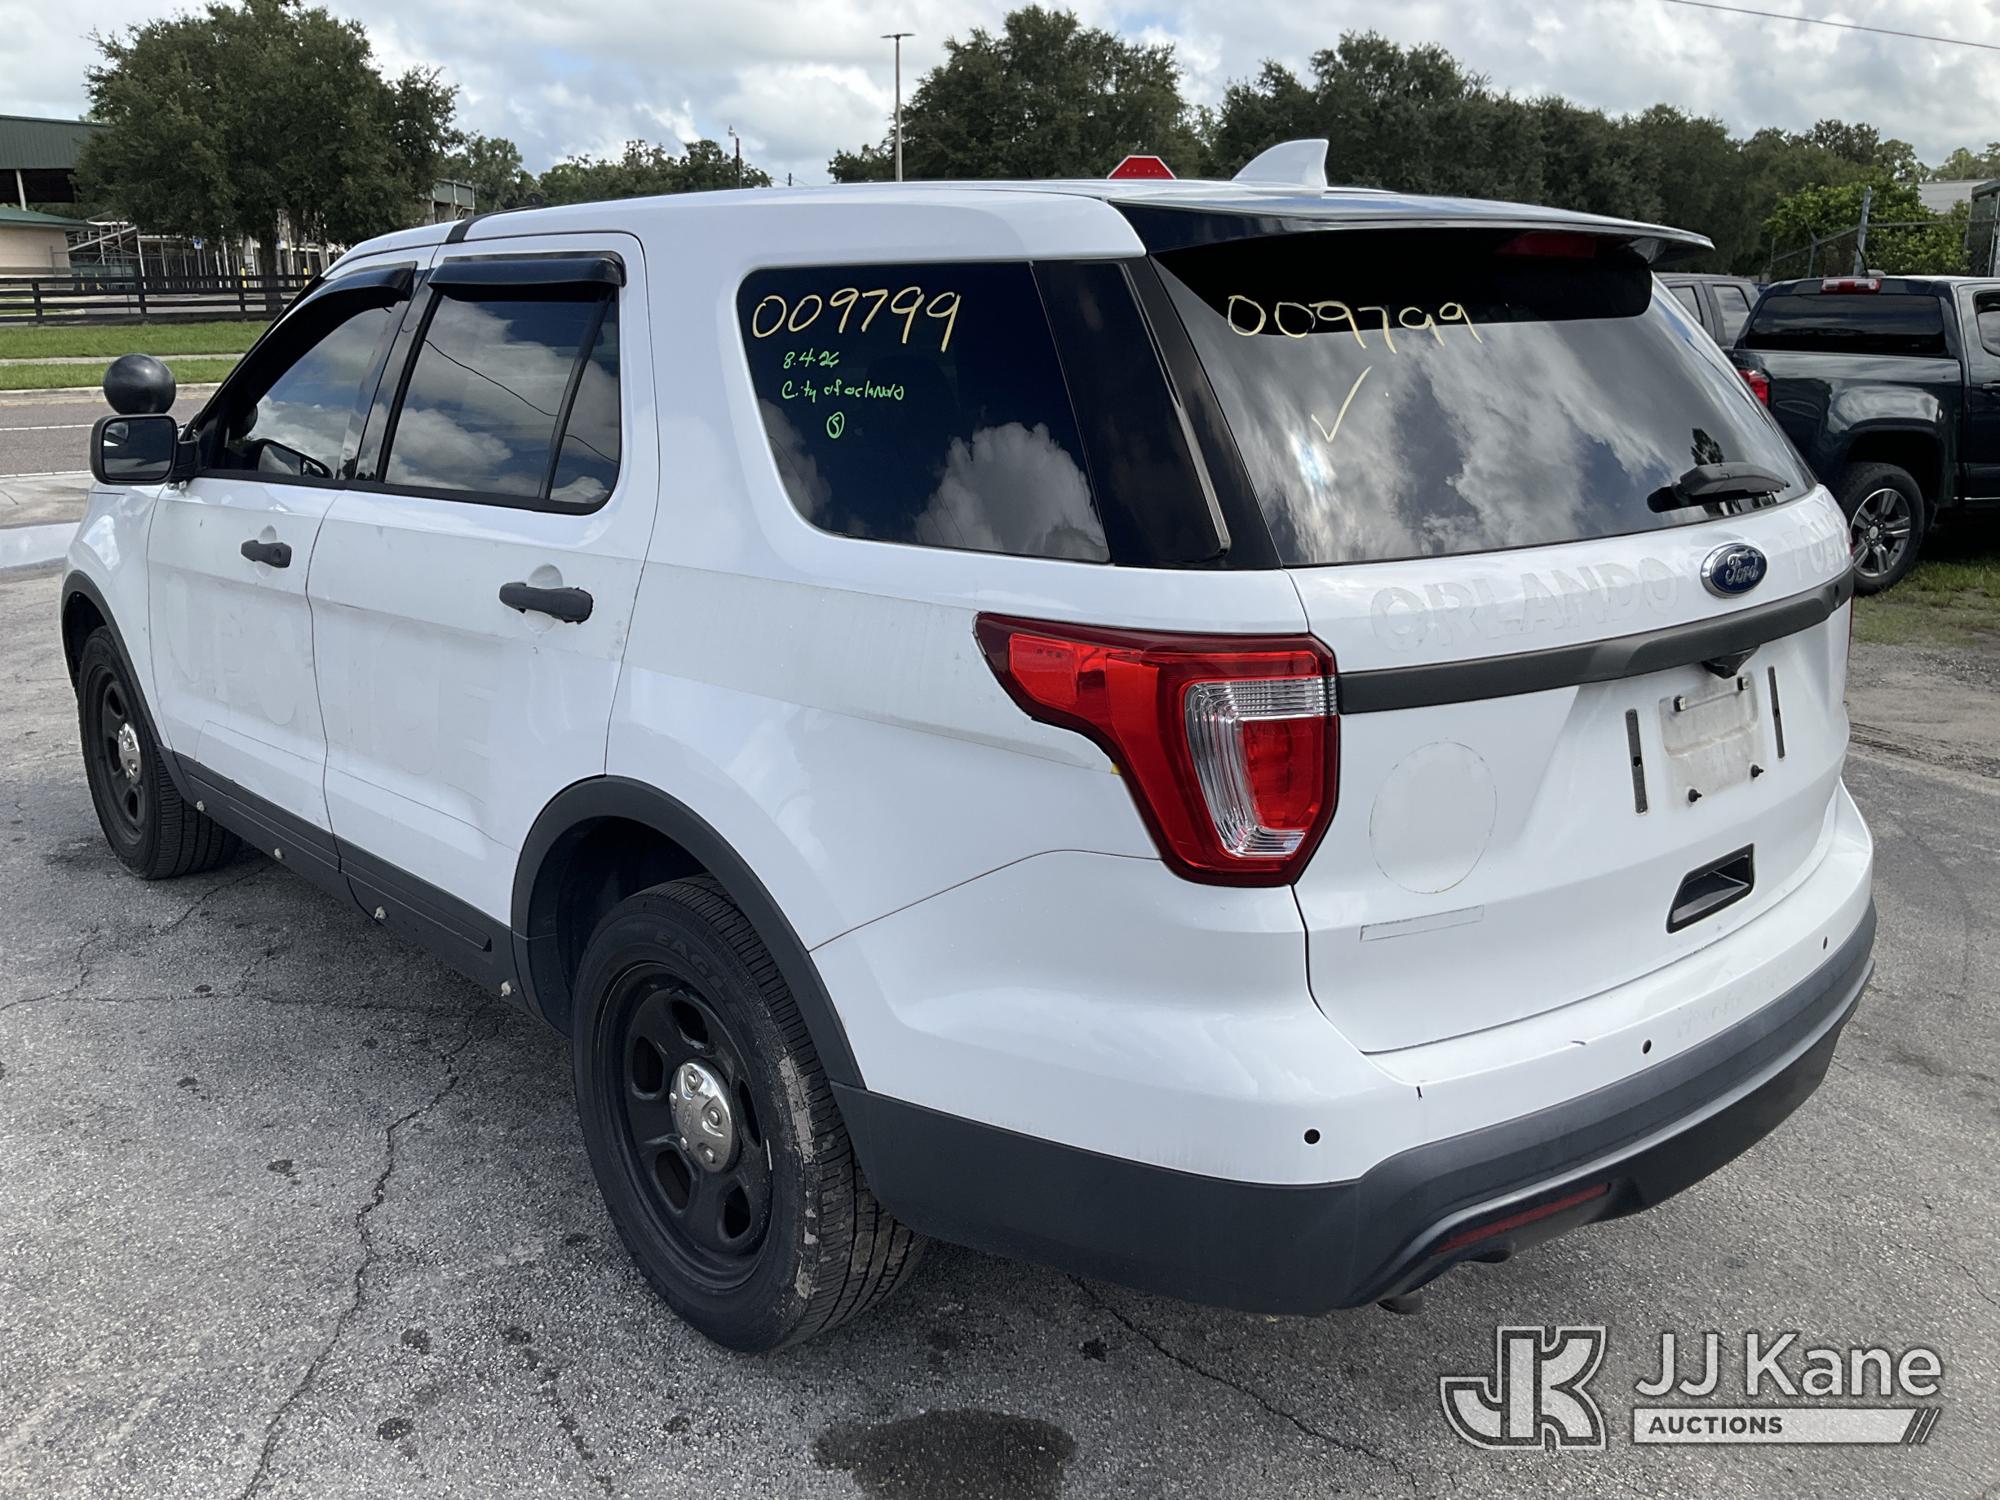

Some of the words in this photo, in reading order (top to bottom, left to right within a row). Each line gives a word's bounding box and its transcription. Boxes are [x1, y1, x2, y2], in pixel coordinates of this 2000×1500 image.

[752, 286, 962, 353] 009799
[1227, 294, 1483, 354] 009799
[1371, 557, 1679, 650] ORLANDO
